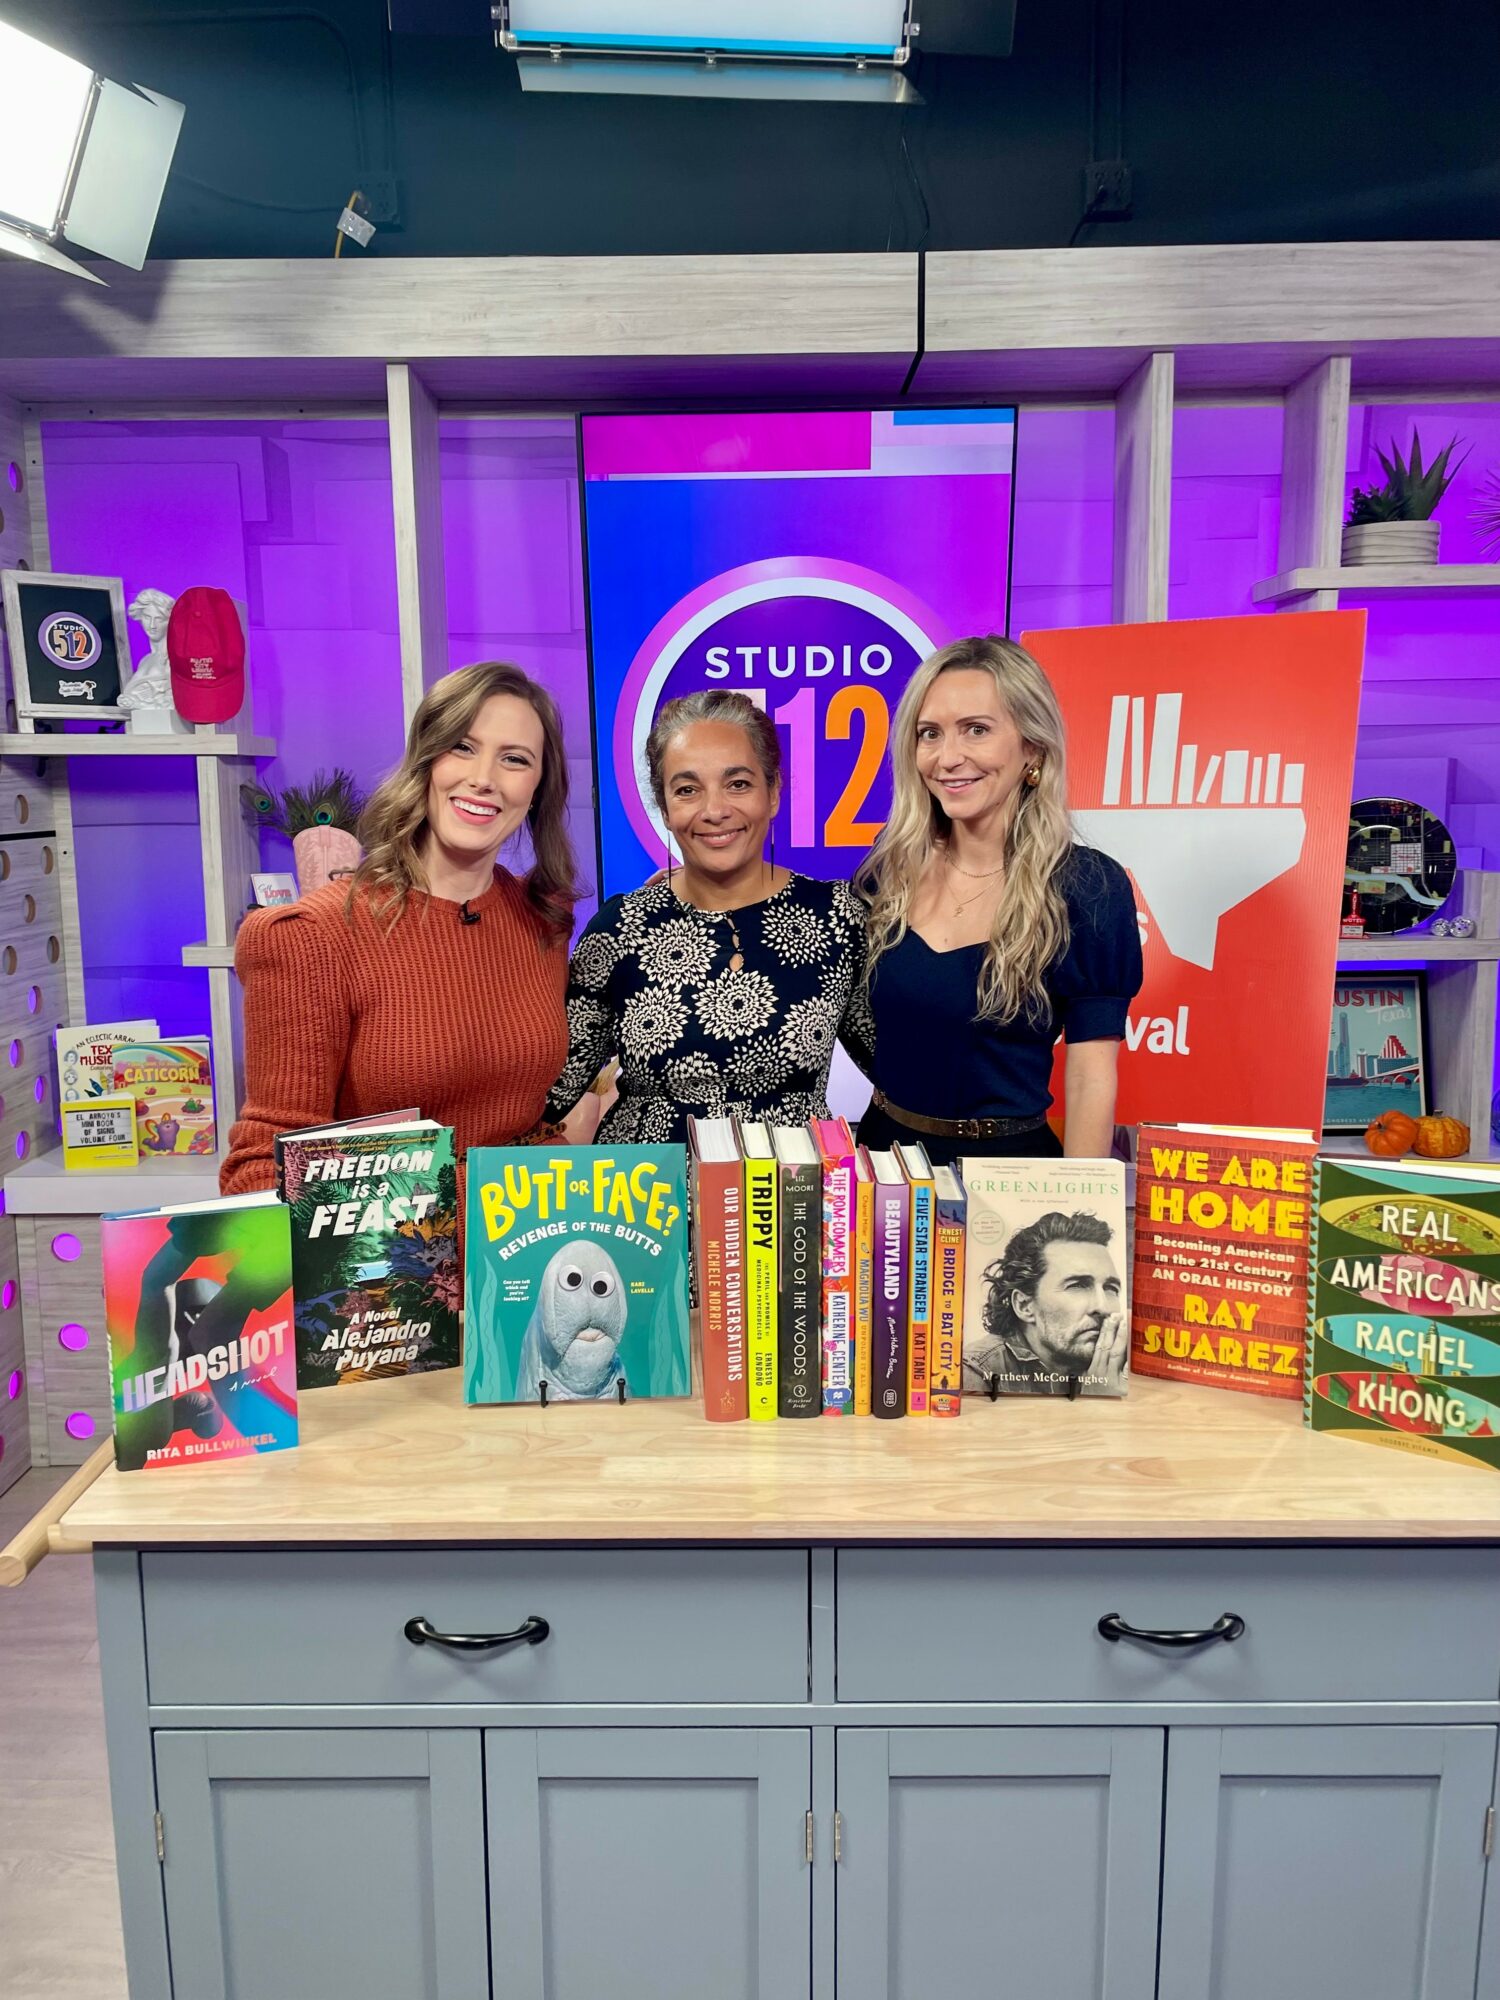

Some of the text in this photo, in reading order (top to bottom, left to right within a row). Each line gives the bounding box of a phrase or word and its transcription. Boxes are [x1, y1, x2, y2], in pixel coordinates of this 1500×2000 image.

[53, 630, 88, 659] 512
[704, 644, 893, 679] STUDIO
[708, 684, 890, 848] 12
[1334, 990, 1404, 1007] USTIN
[80, 1056, 113, 1066] MUSIC
[91, 1045, 112, 1055] TEX
[124, 1068, 200, 1082] CATICORN
[80, 1136, 106, 1144] VOLUME
[304, 1150, 434, 1182] FREEDOM
[1151, 1147, 1306, 1194] WE ARE
[352, 1180, 389, 1198] is a
[480, 1159, 572, 1242] BUTT
[570, 1180, 590, 1196] OR
[593, 1159, 680, 1236] FACE?
[724, 1188, 738, 1214] OUR
[970, 1180, 1119, 1195] GREENLIGHTS
[308, 1194, 437, 1238] FEAST
[753, 1173, 772, 1249] TRIPPY
[833, 1172, 846, 1273] THE ROM-COMMERS
[1150, 1186, 1305, 1240] HOME
[1381, 1205, 1458, 1242] REAL
[498, 1221, 663, 1261] REVENGE OF THE BUTTS
[725, 1219, 740, 1267] HIDDEN
[884, 1200, 900, 1300] BEAUTYLAND
[915, 1198, 928, 1313] FIVE-STAR STRANGER
[1153, 1235, 1296, 1263] Becoming American
[943, 1248, 956, 1296] BRIDGE
[1152, 1268, 1294, 1298] AN ORAL HISTORY
[1155, 1251, 1293, 1282] in the 21st Century
[1330, 1258, 1500, 1312] AMERICANS
[708, 1241, 722, 1330] MICHELE NORRIS
[794, 1202, 806, 1375] THE GOD OF THE WOODS
[859, 1259, 869, 1322] MAGNOLIA WU
[350, 1306, 400, 1325] A Novel
[726, 1273, 742, 1381] CONVERSATIONS
[833, 1295, 846, 1344] KATHERINE
[942, 1313, 953, 1337] BAT
[1184, 1294, 1260, 1331] RAY
[321, 1319, 431, 1350] Alejandro
[1144, 1325, 1299, 1376] SUAREZ
[1355, 1321, 1474, 1369] RACHEL
[122, 1320, 289, 1412] HEADSHOT
[335, 1344, 419, 1372] Puyana
[756, 1352, 764, 1386] LONDOÑO
[832, 1351, 845, 1385] CENTER
[914, 1333, 925, 1380] KAT TANG
[941, 1342, 952, 1370] CITY
[983, 1371, 1109, 1385] Mtthew McCoughey
[1358, 1380, 1466, 1427] KHONG
[147, 1433, 277, 1460] RITA BULLWINKEL
